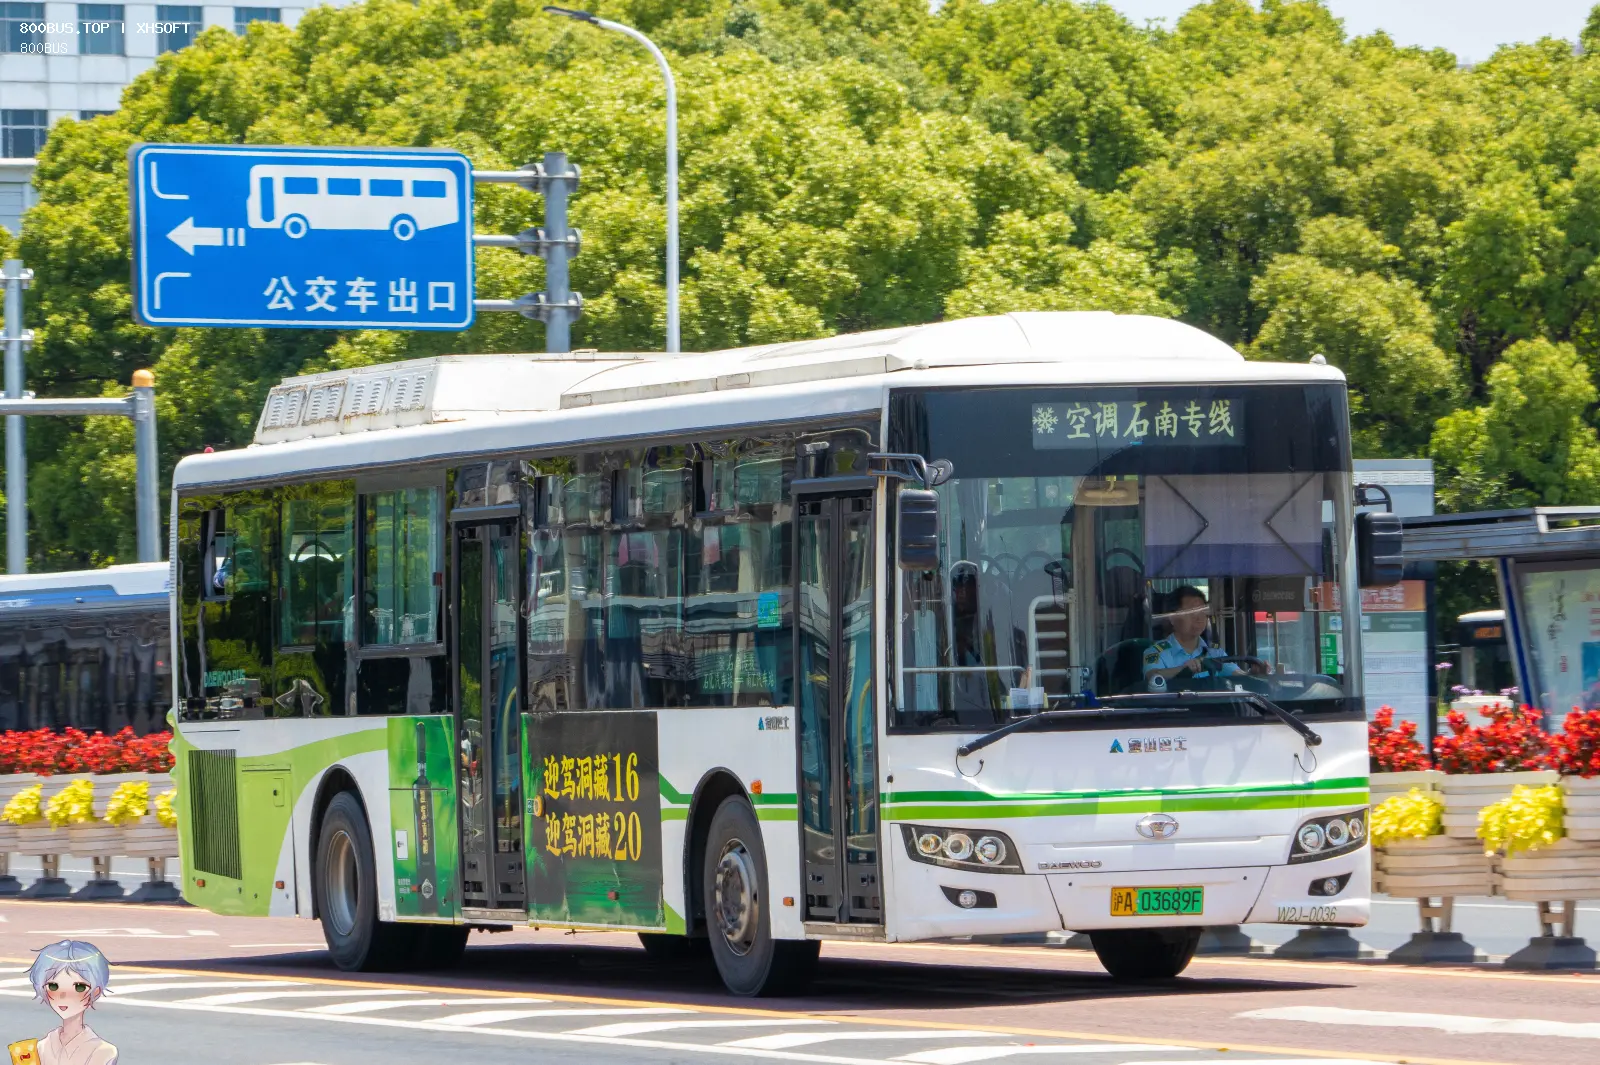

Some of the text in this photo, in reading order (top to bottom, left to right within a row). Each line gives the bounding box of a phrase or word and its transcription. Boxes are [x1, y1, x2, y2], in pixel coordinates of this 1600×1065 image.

[263, 275, 456, 314] 公交车出口
[1066, 400, 1235, 439] 空调石南专线
[1127, 736, 1188, 754] 金山巴士
[1037, 860, 1103, 871] DAEWOO
[1277, 905, 1338, 922] W2J-0036
